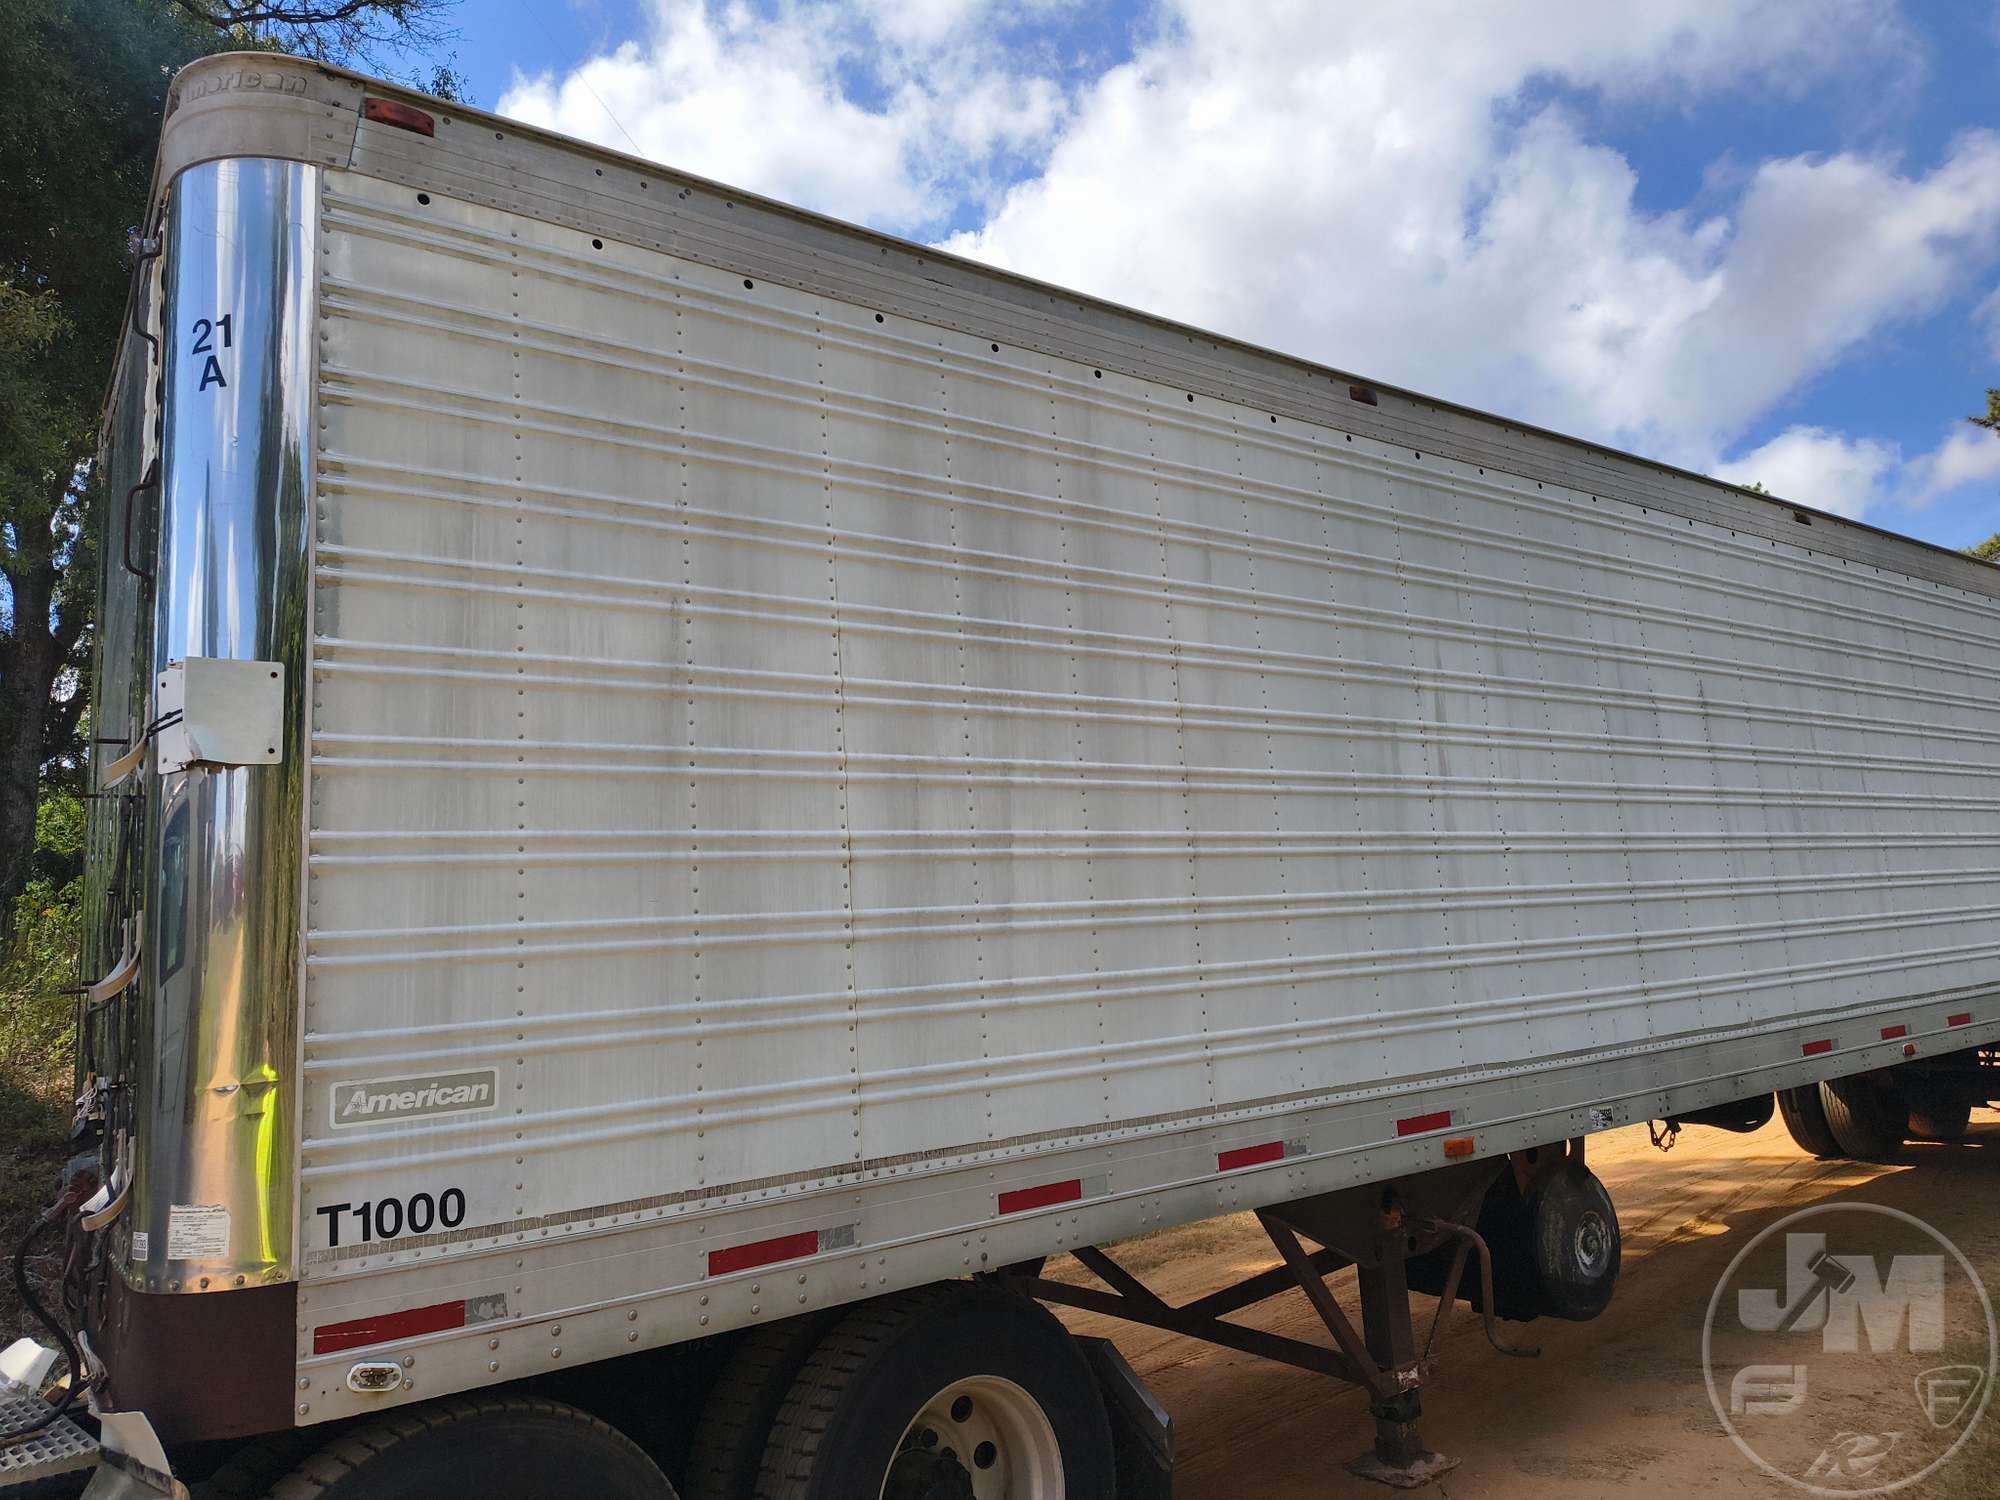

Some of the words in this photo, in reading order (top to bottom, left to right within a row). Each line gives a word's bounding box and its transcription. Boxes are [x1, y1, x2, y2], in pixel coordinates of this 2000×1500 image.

[192, 313, 233, 355] 21
[199, 354, 228, 392] A
[341, 1082, 489, 1118] American
[316, 1187, 467, 1248] T1000
